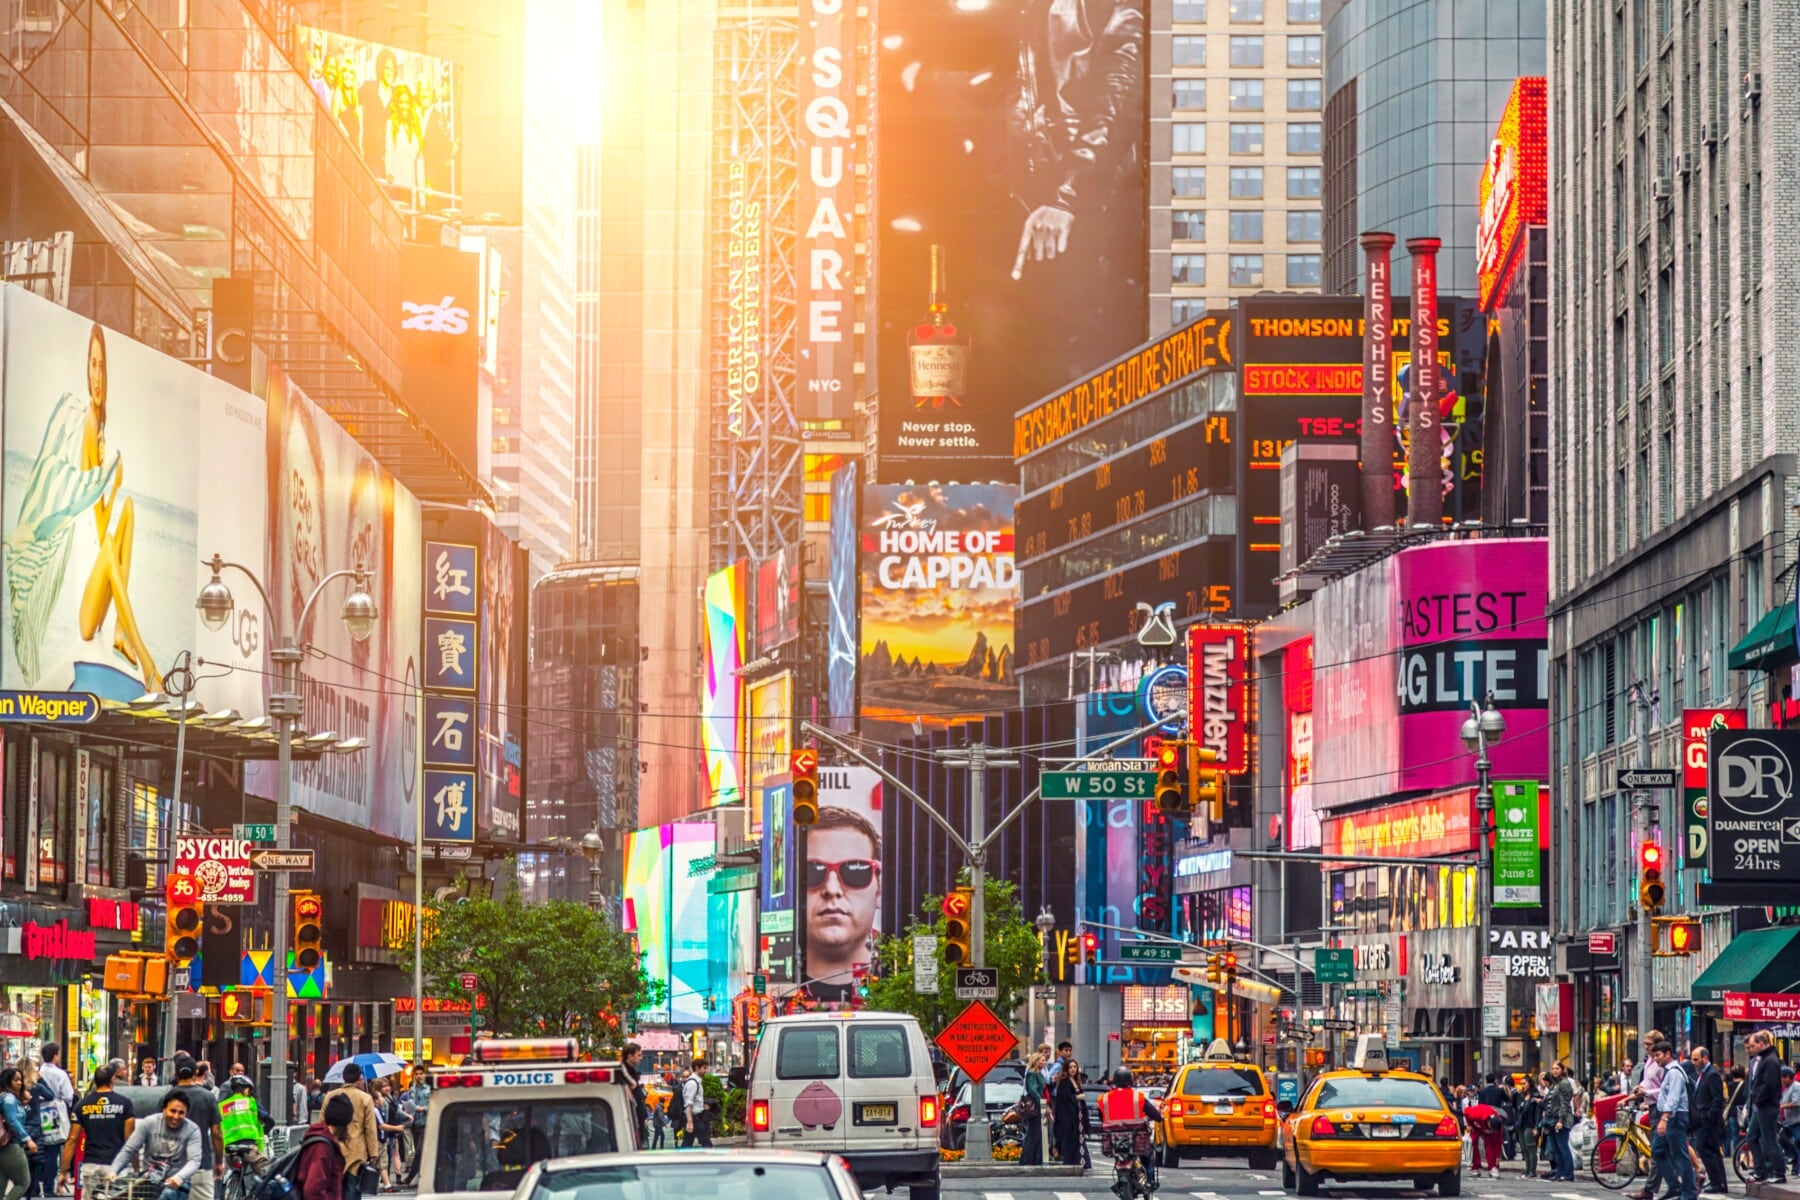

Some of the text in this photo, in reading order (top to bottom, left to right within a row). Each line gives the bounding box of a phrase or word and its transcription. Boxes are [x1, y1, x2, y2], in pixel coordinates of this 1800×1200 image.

[805, 46, 851, 342] SQUARE
[728, 160, 745, 438] AMERICAN EAGLE
[743, 200, 761, 394] OUTFITTERS
[1250, 319, 1353, 336] THOMSON
[1370, 262, 1385, 424] HERSHEYS
[1417, 268, 1433, 428] HERSHEYS
[809, 379, 842, 392] NYC
[1249, 369, 1312, 390] STOCK
[902, 421, 976, 434] Never stop.
[898, 436, 980, 447] Never settle.
[880, 531, 1001, 553] HOME OF
[878, 555, 1022, 590] CAPPAD
[231, 608, 258, 658] UGG
[1436, 649, 1517, 703] LTE
[18, 694, 87, 721] Wagner
[818, 772, 851, 790] HILL
[1064, 776, 1146, 794] W 50 St
[1627, 774, 1669, 784] ONE WAY
[255, 827, 266, 839] 50
[1499, 828, 1534, 839] TASTE
[175, 838, 252, 860] PSYCHIC
[1734, 838, 1780, 854] OPEN
[261, 855, 305, 865] ONE WAY
[1735, 854, 1781, 870] 24hrs
[1499, 869, 1525, 879] June
[1143, 949, 1158, 958] 49
[1511, 955, 1547, 967] OPEN
[1511, 966, 1526, 977] 24
[959, 987, 995, 997] BIKE PATH
[1749, 998, 1766, 1008] The
[1766, 998, 1788, 1008] Anne
[1761, 1007, 1776, 1017] The
[955, 1023, 998, 1031] CONSTRUCTION
[956, 1034, 969, 1042] BIKE
[970, 1034, 985, 1042] LANE
[986, 1034, 1005, 1042] AHEAD
[957, 1044, 983, 1053] PROCEED
[965, 1055, 989, 1063] CAUTION
[493, 1072, 554, 1086] POLICE
